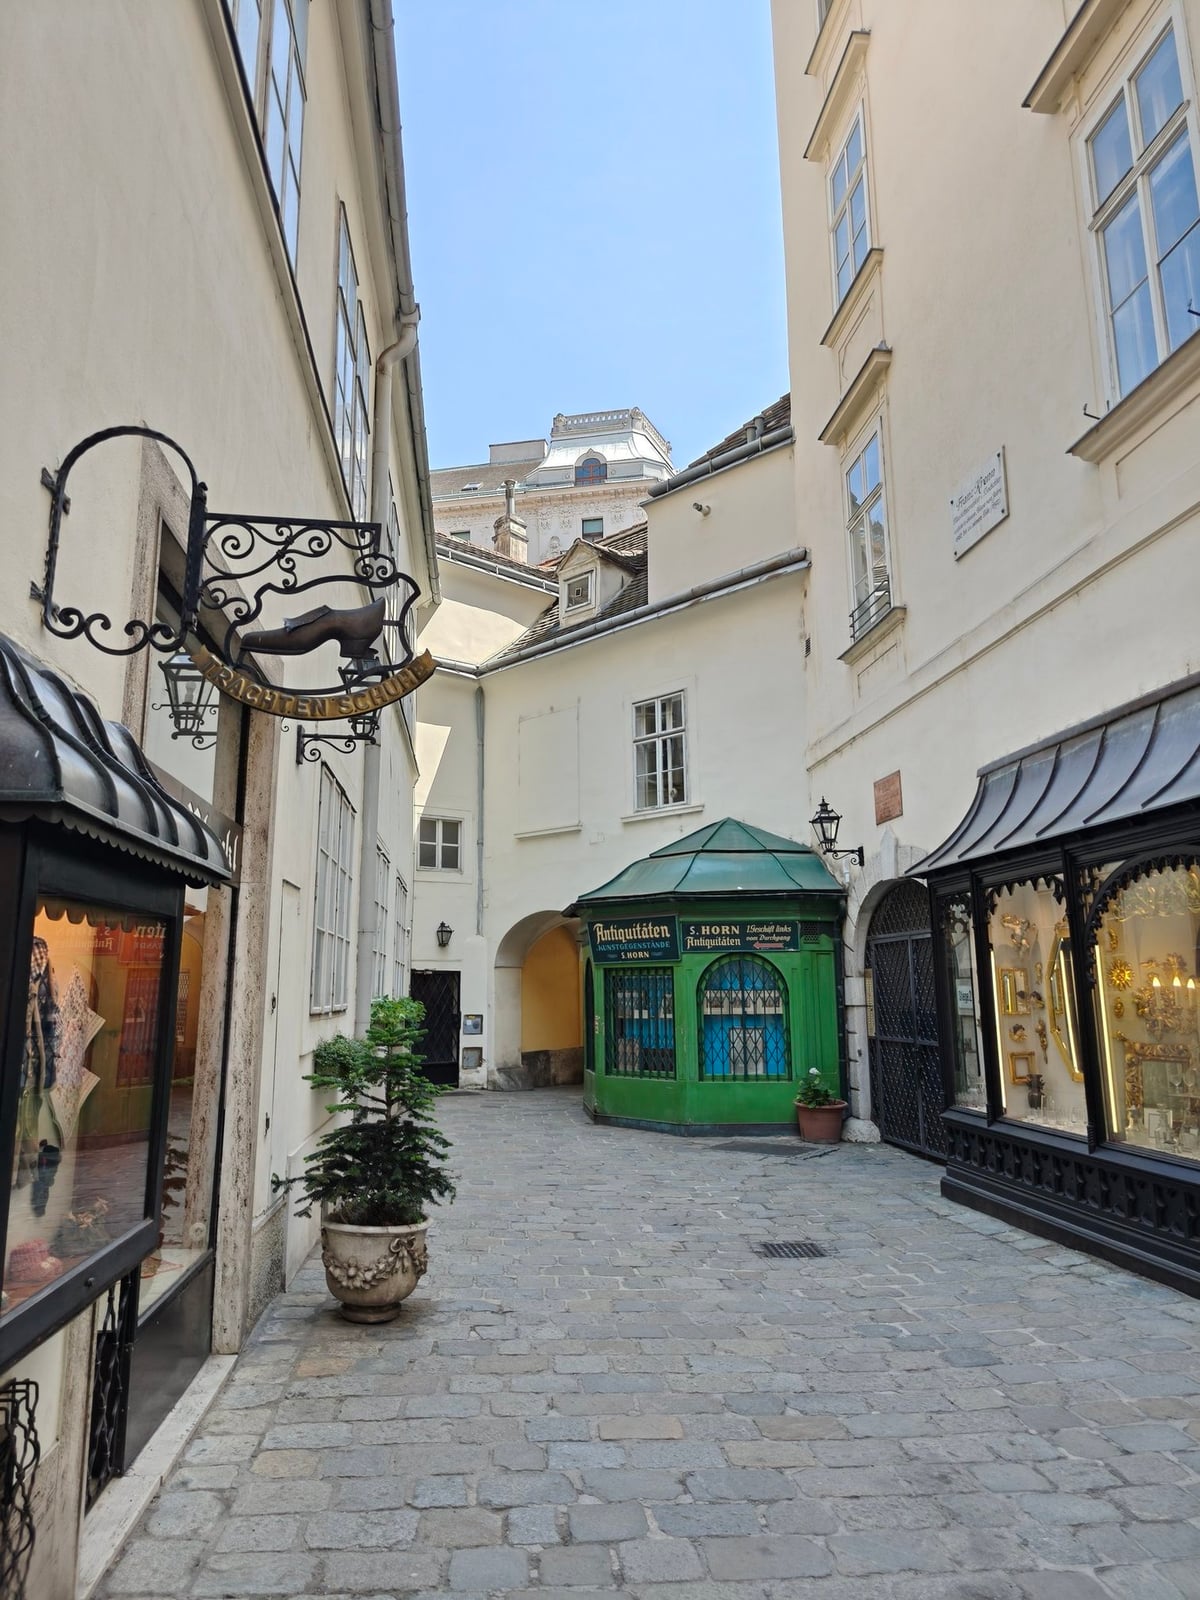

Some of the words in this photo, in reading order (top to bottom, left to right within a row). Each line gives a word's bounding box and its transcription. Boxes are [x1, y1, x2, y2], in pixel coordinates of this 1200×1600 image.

[205, 653, 328, 717] TRACHTEN
[593, 921, 671, 945] Antiquitäten
[689, 925, 699, 935] S.
[701, 924, 740, 935] HORN
[597, 940, 671, 952] KUNSTGEGENSTÄNDE
[685, 935, 742, 950] Antiquitäten
